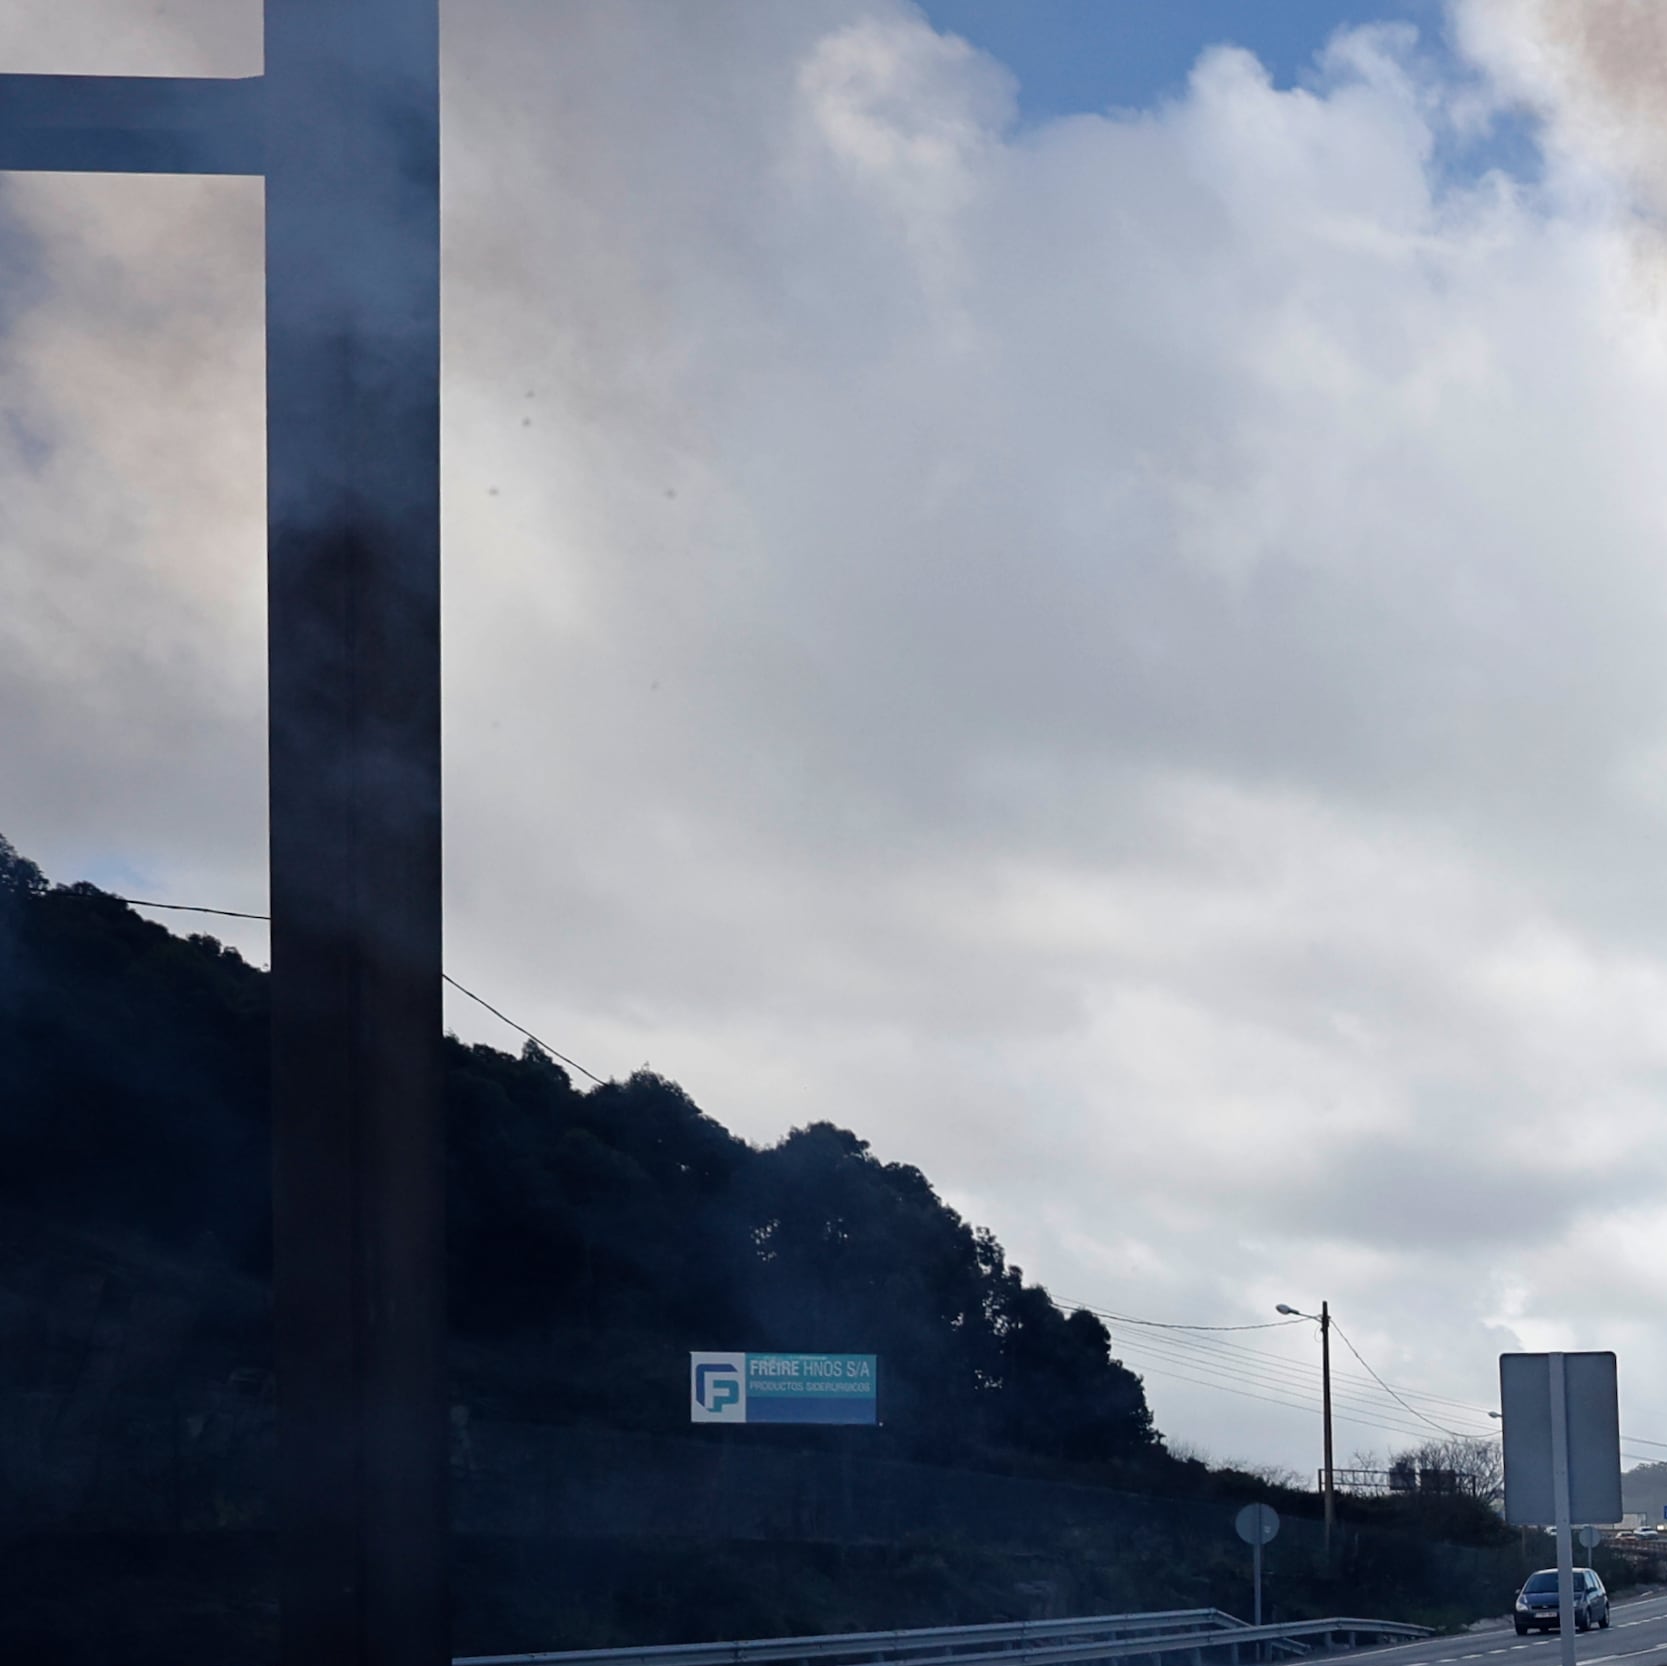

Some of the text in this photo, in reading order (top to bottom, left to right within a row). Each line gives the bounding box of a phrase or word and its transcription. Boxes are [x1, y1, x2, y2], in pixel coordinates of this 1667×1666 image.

[803, 1361, 842, 1377] HNOS
[846, 1361, 870, 1377] S/A
[749, 1381, 803, 1392] PRODUCTOS
